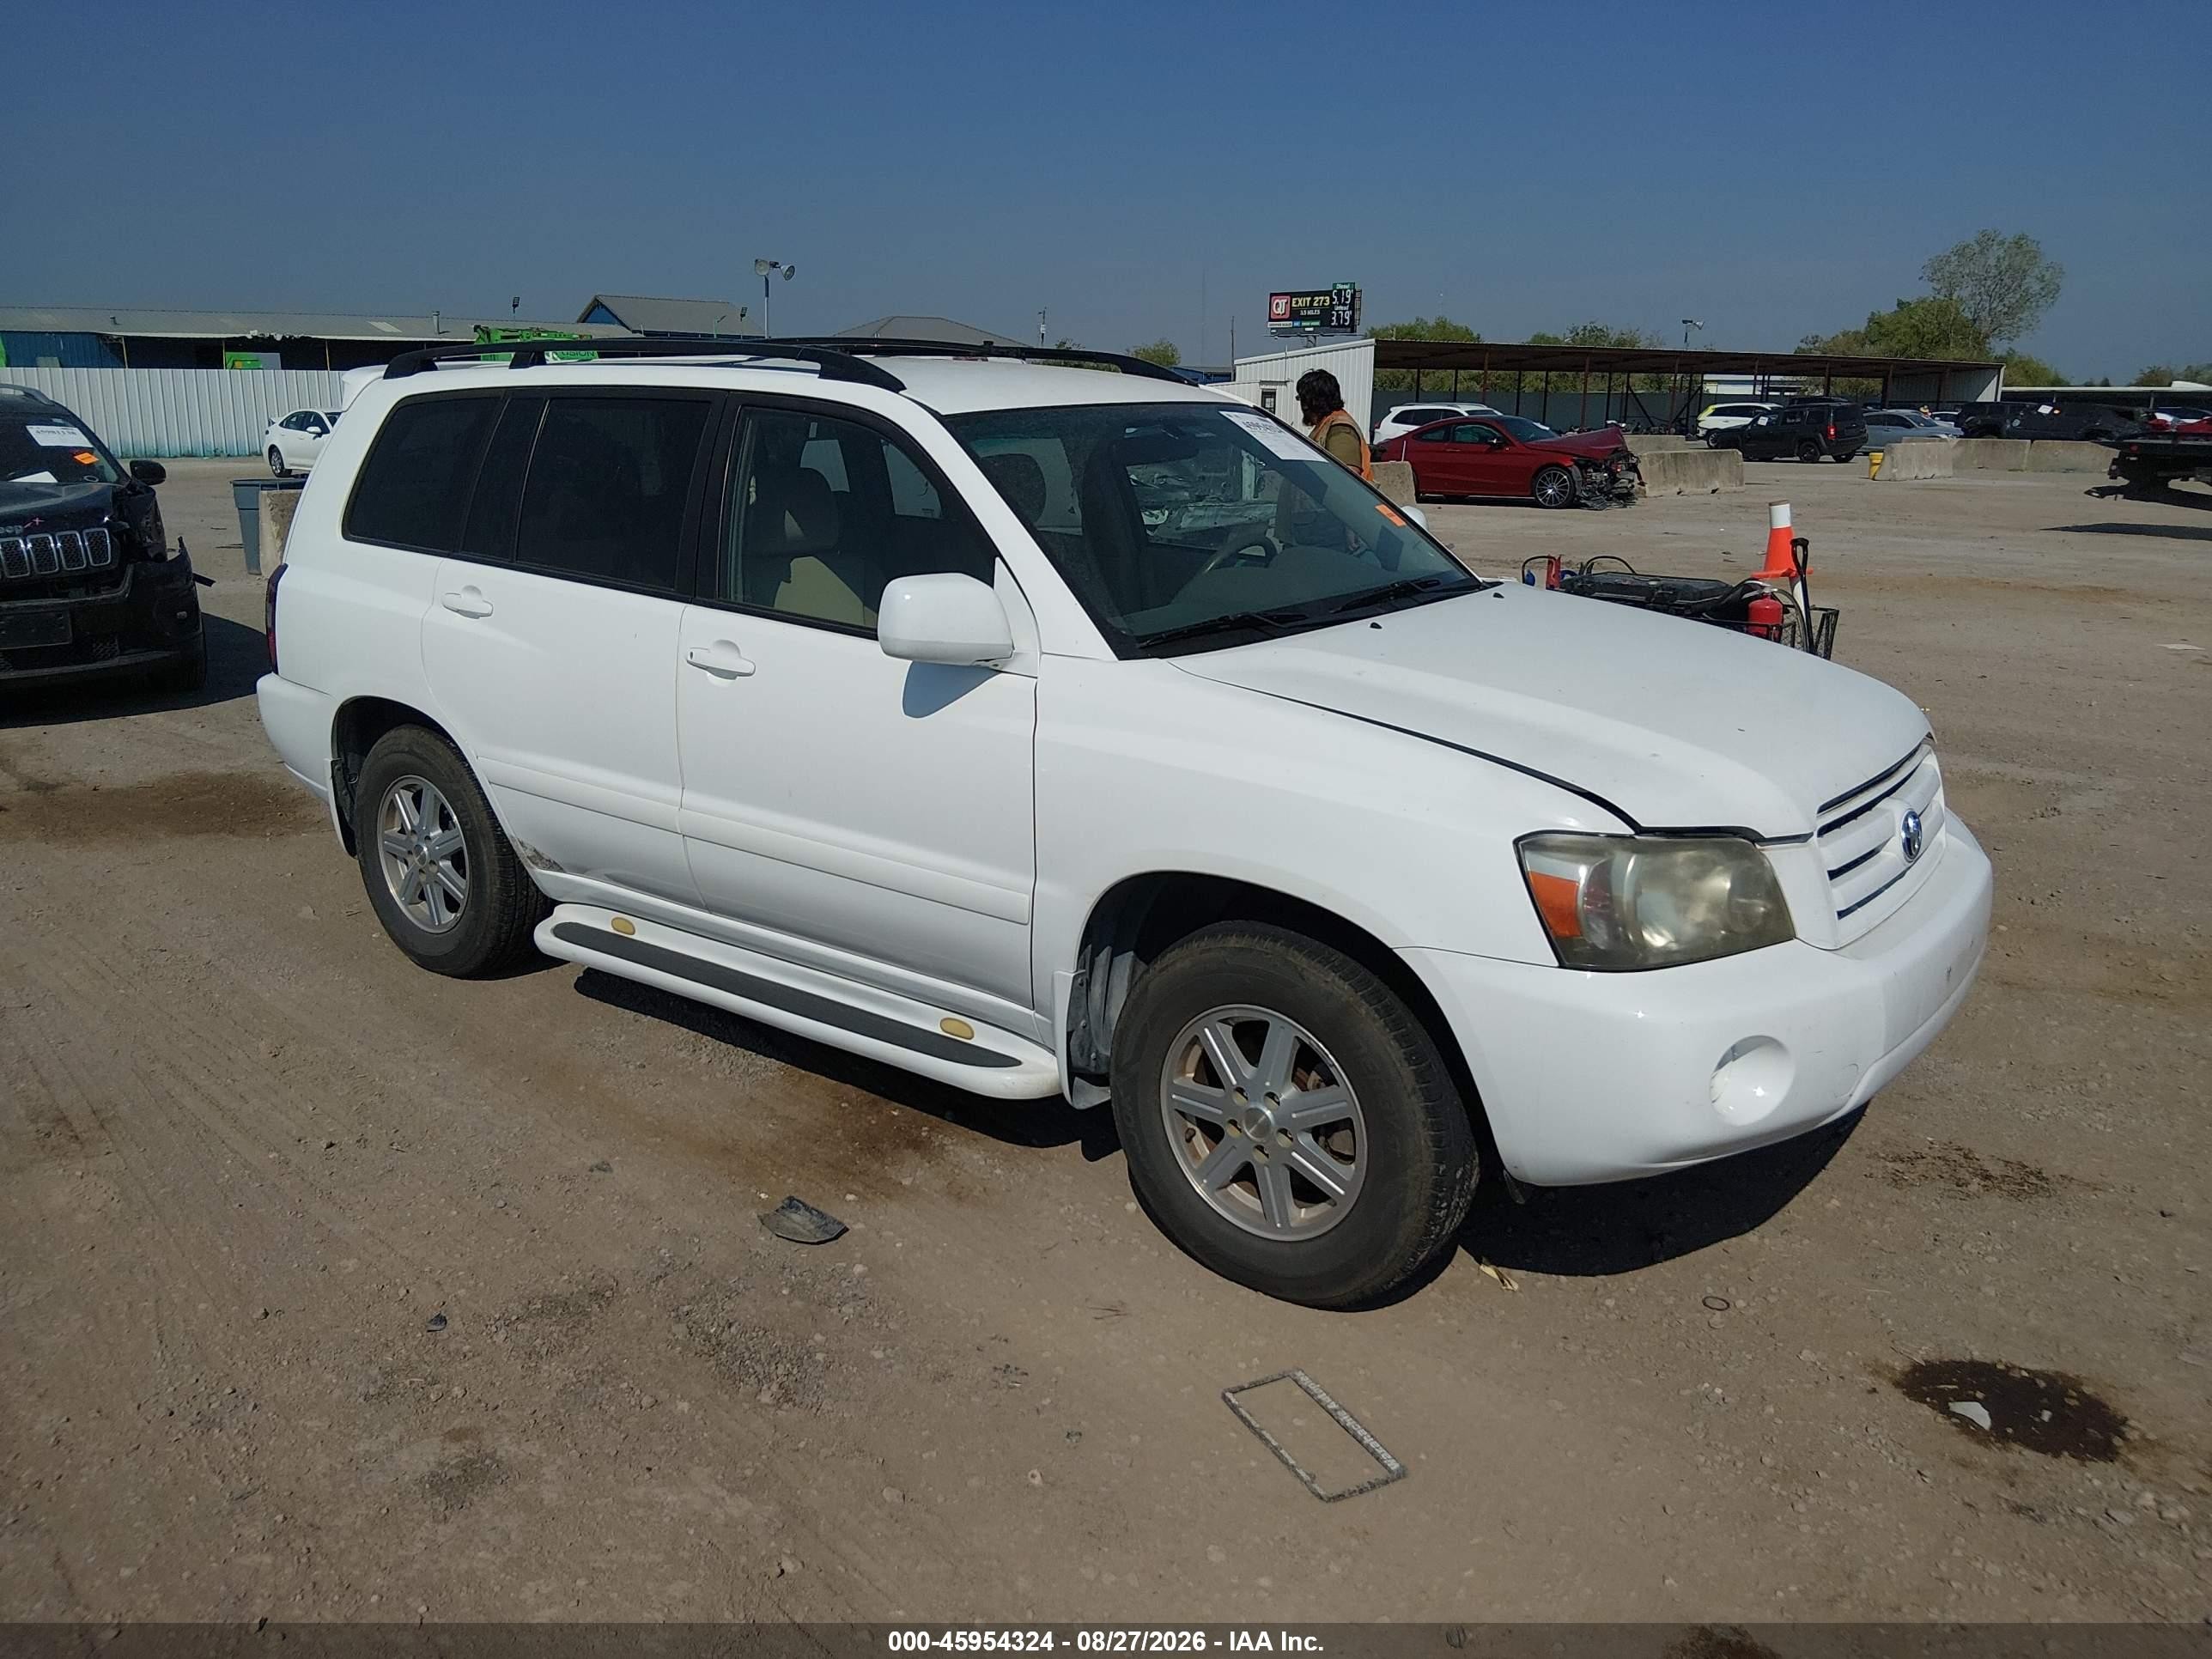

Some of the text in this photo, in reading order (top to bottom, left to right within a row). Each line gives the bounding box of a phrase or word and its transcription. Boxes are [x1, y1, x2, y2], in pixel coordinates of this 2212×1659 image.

[1273, 299, 1287, 315] QT
[1291, 295, 1330, 307] EXIT 273
[0, 526, 23, 534] eep
